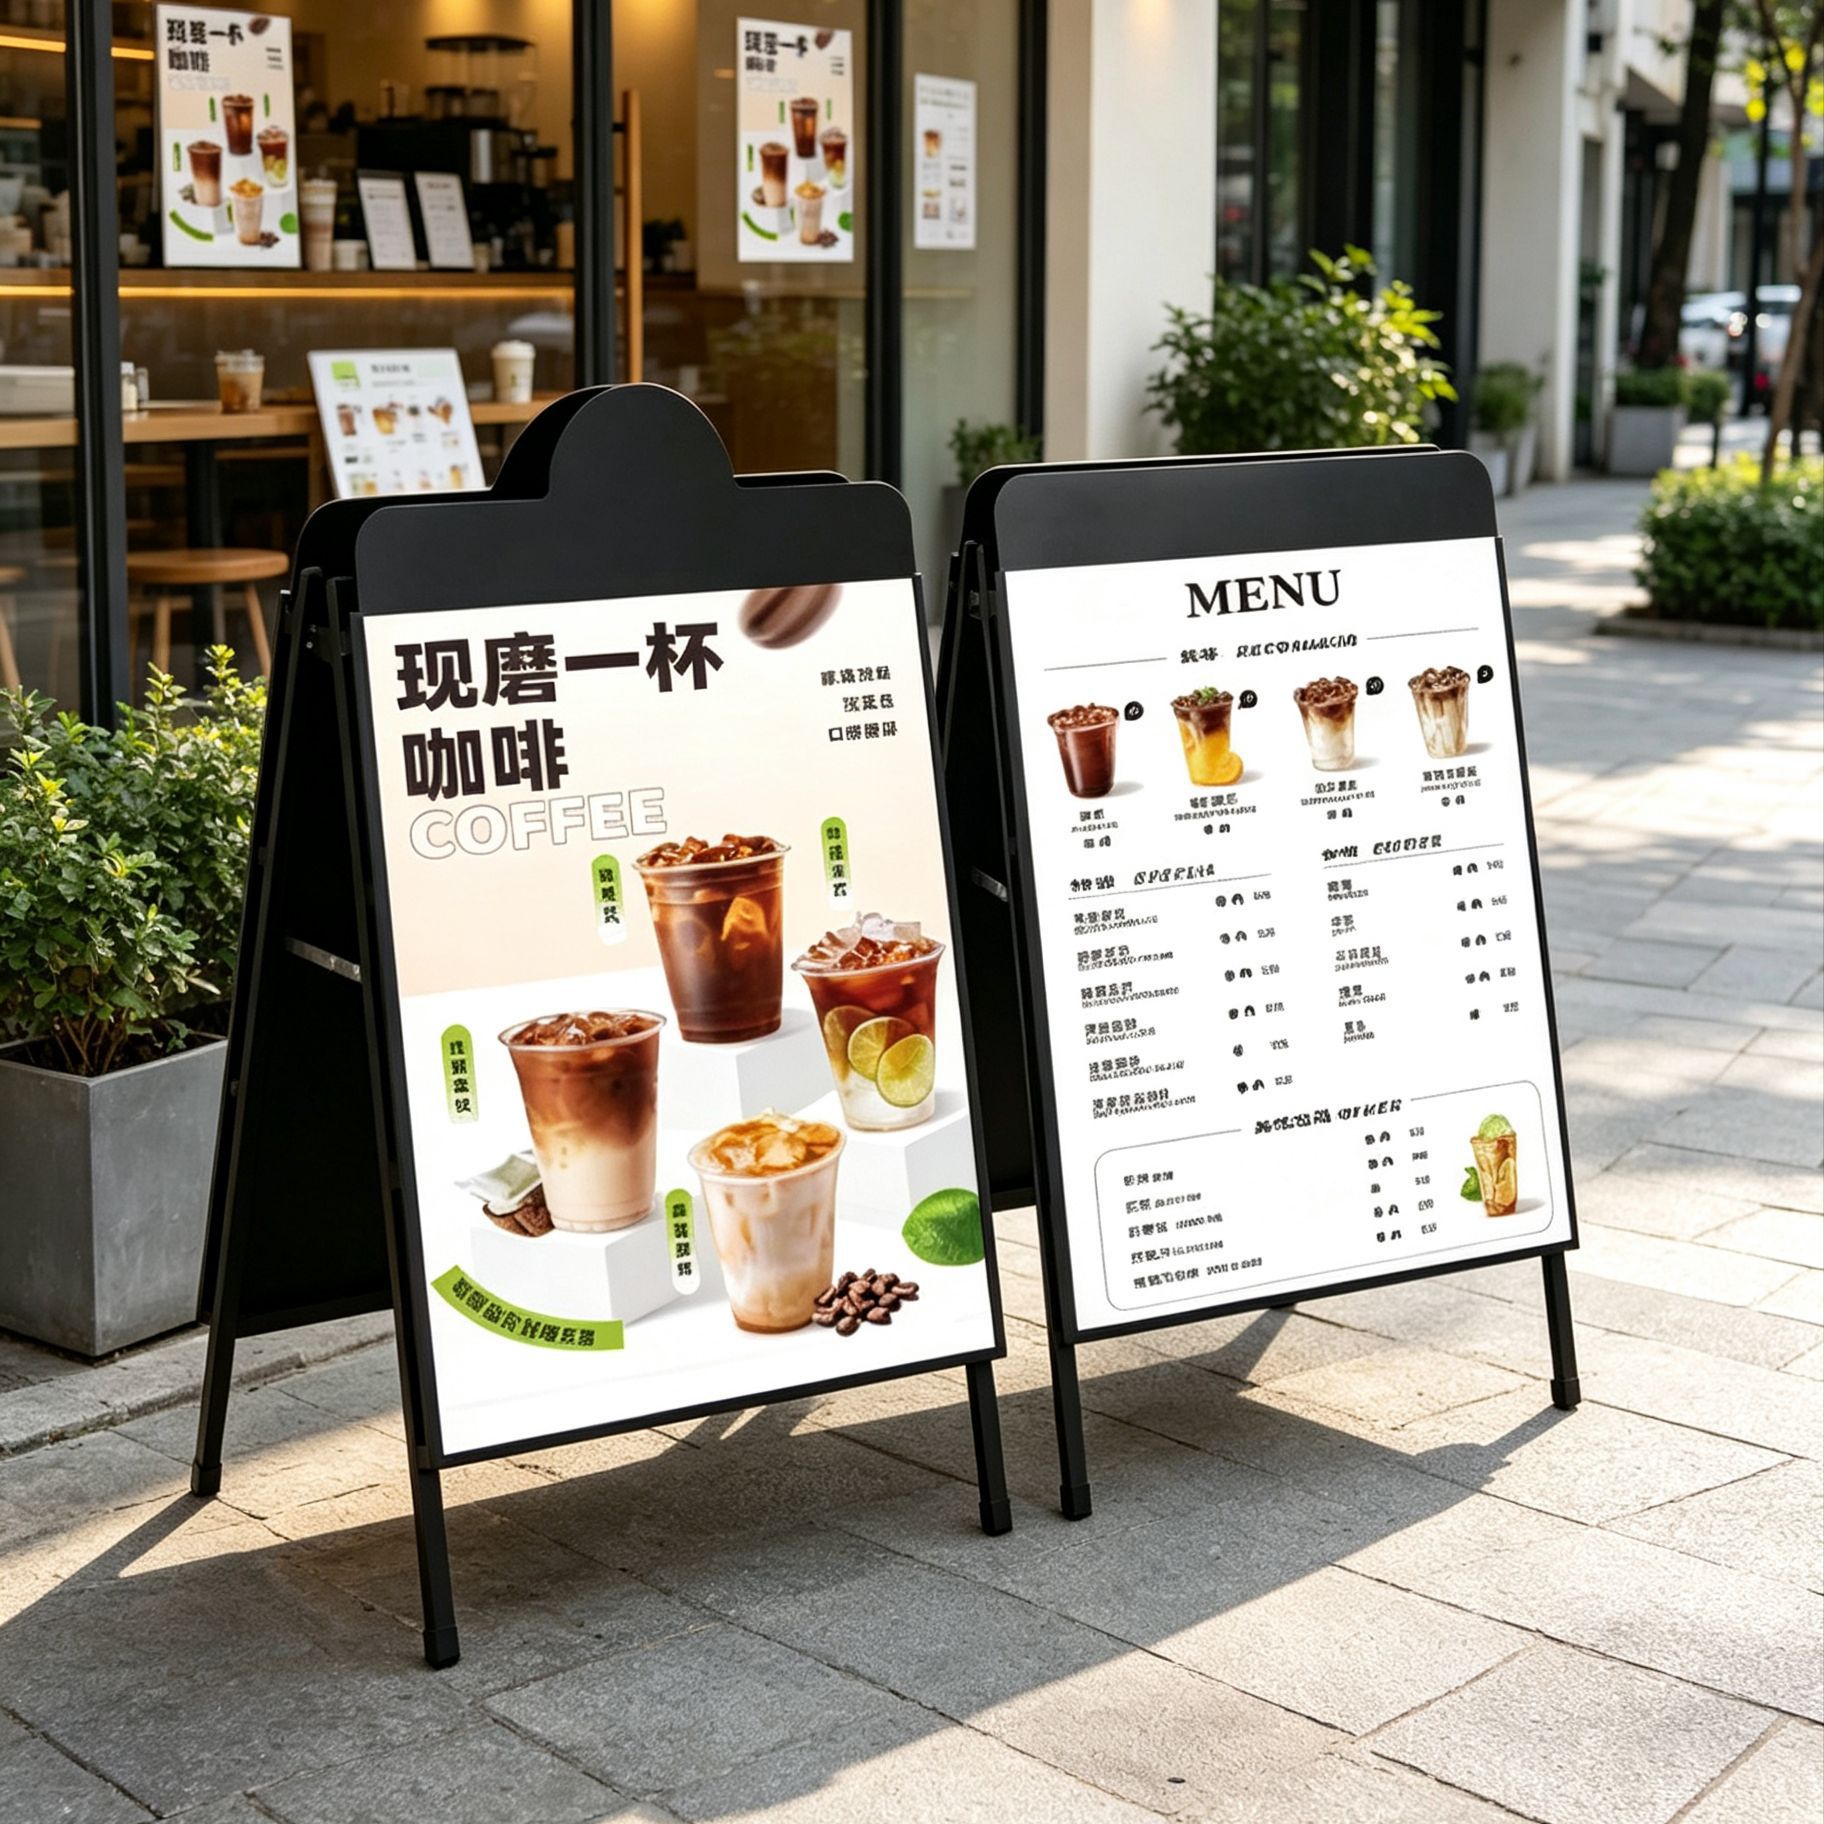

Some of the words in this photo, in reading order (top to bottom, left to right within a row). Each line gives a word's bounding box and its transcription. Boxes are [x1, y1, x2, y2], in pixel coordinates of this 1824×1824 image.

[1185, 569, 1341, 619] MENU
[394, 622, 724, 712] 现磨一杯
[402, 718, 569, 802] 咖啡
[409, 786, 668, 860] COFFEE
